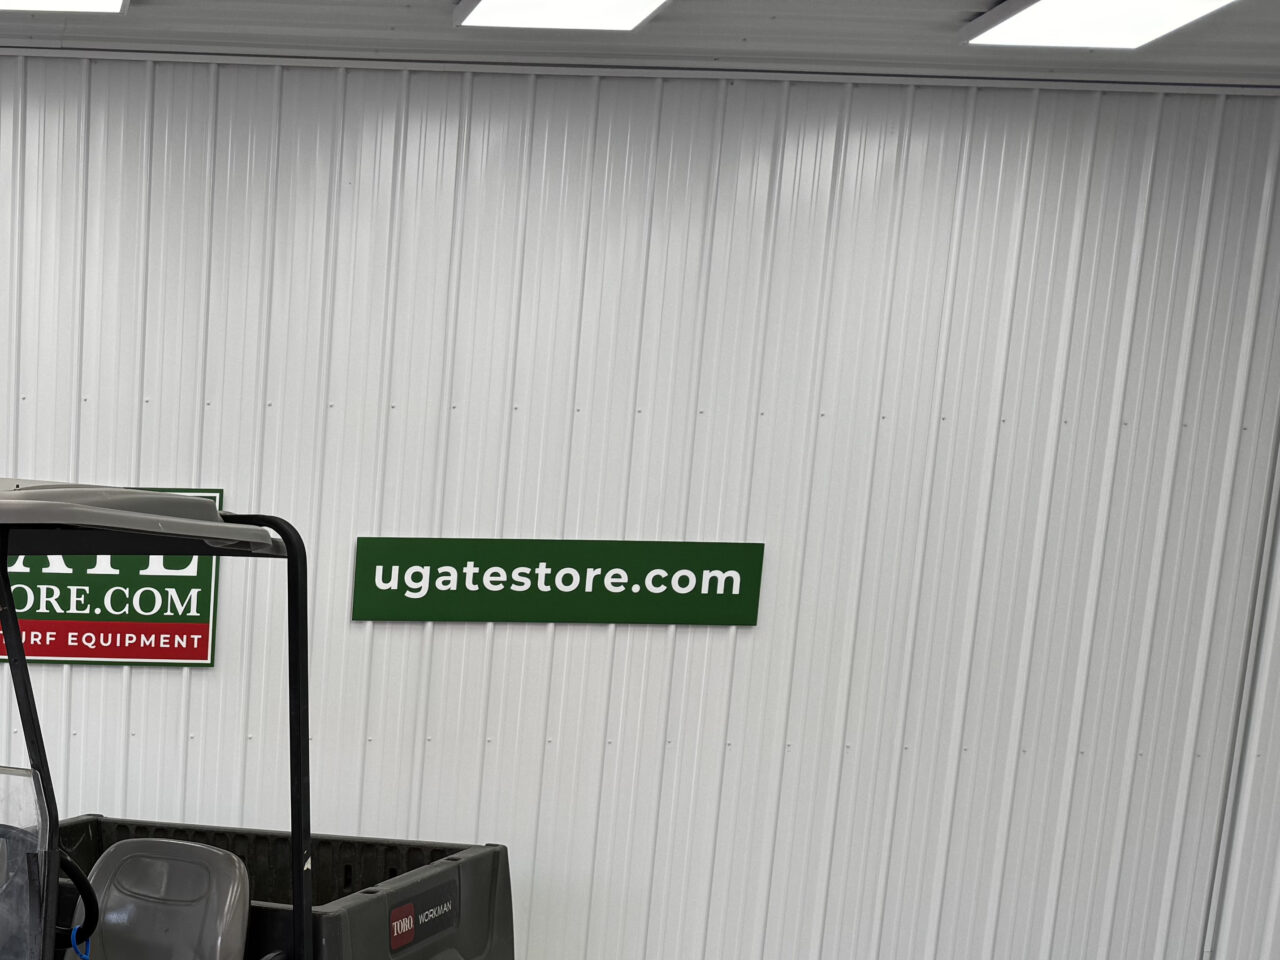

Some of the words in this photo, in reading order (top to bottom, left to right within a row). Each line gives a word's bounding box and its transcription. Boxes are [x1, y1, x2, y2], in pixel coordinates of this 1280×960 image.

[374, 560, 741, 598] ugatestore.com
[0, 630, 57, 645] RF
[67, 632, 202, 649] EQUIPMENT
[392, 915, 413, 937] TORO
[418, 900, 452, 925] WORKMAN
